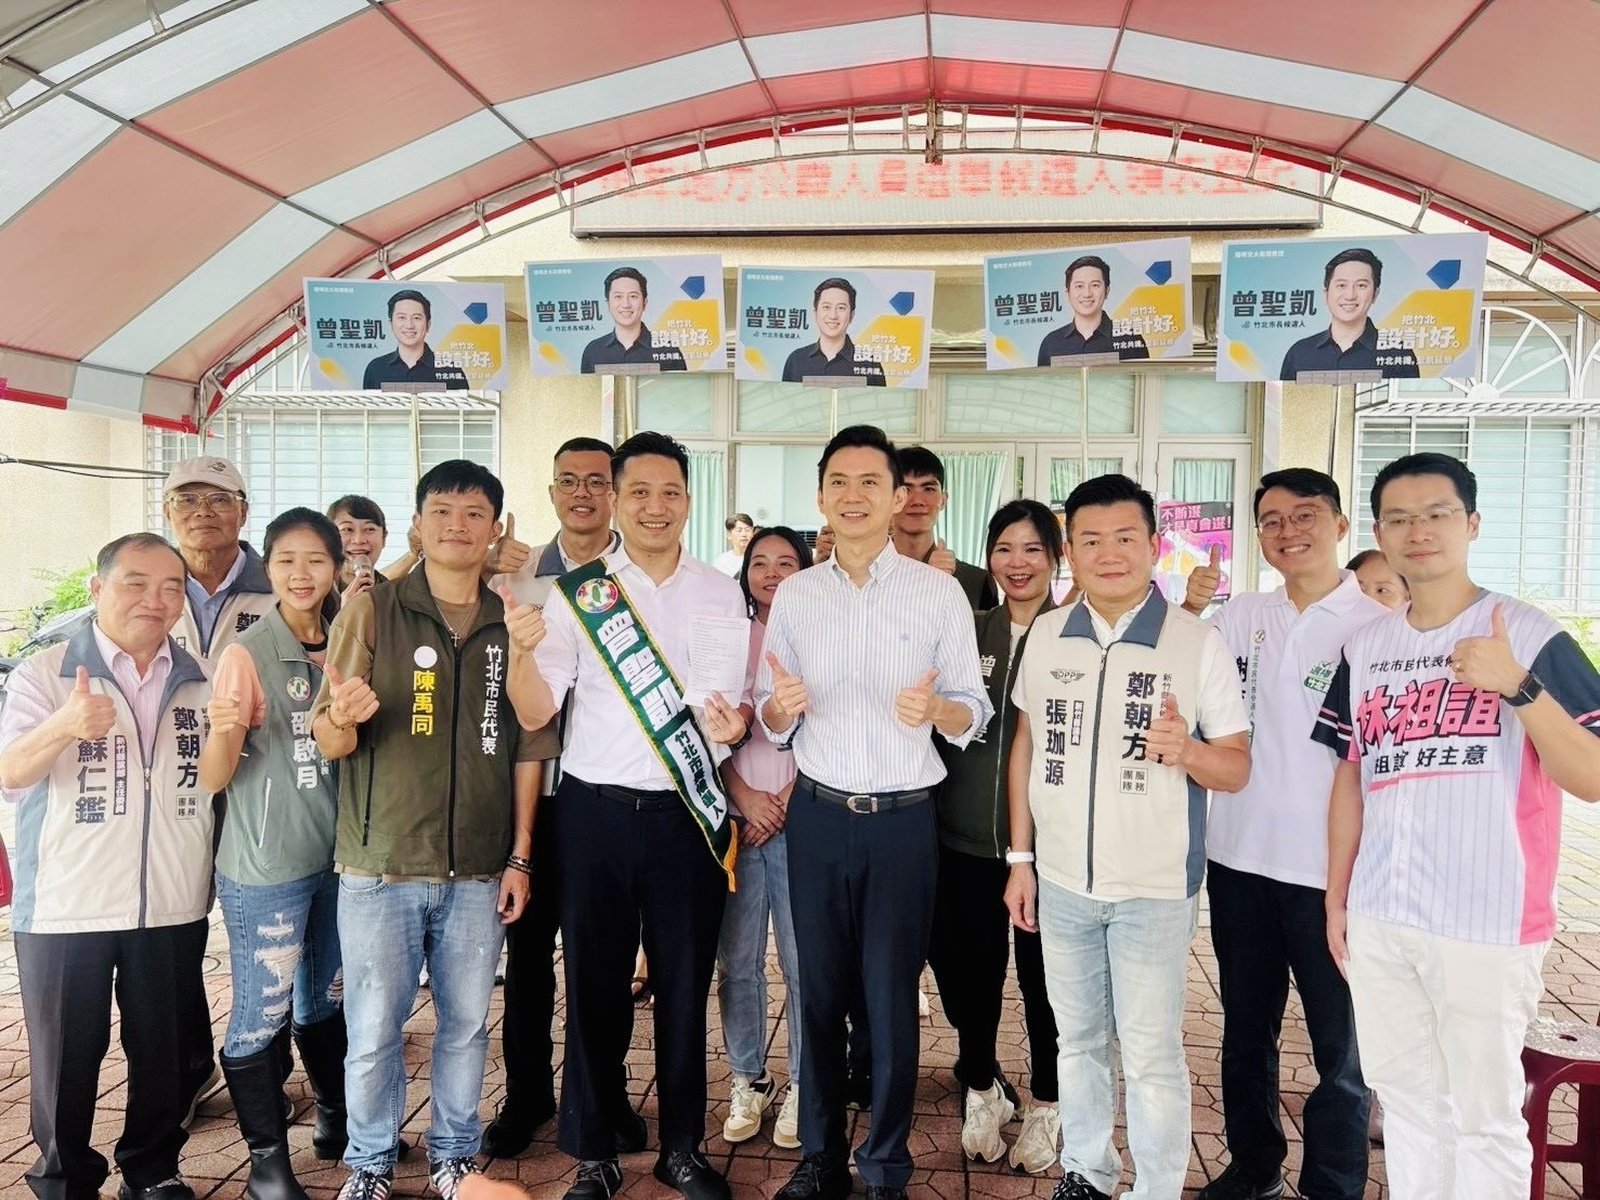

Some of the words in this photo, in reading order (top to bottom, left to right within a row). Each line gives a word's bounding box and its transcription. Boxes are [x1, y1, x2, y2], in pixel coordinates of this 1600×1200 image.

[536, 300, 603, 323] 曾聖凱
[994, 290, 1062, 317] 曾聖凱
[1232, 289, 1317, 317] 曾聖凱
[316, 317, 386, 340] 曾聖凱
[746, 305, 809, 330] 曾聖凱
[1253, 320, 1306, 329] 竹北市長候選人
[1401, 314, 1437, 325] 把竹北
[1161, 504, 1202, 521] 不賄選
[597, 610, 687, 732] 曾聖凱
[411, 670, 436, 736] 陳禹同
[481, 645, 503, 756] 竹北市民代表
[1121, 671, 1157, 761] 鄭朝方
[1356, 678, 1502, 757] 林祖誼
[172, 706, 201, 789] 鄭朝方
[1045, 698, 1067, 786] 張珈源
[1416, 744, 1488, 768] 好主意
[75, 736, 109, 824] 蘇仁鑑
